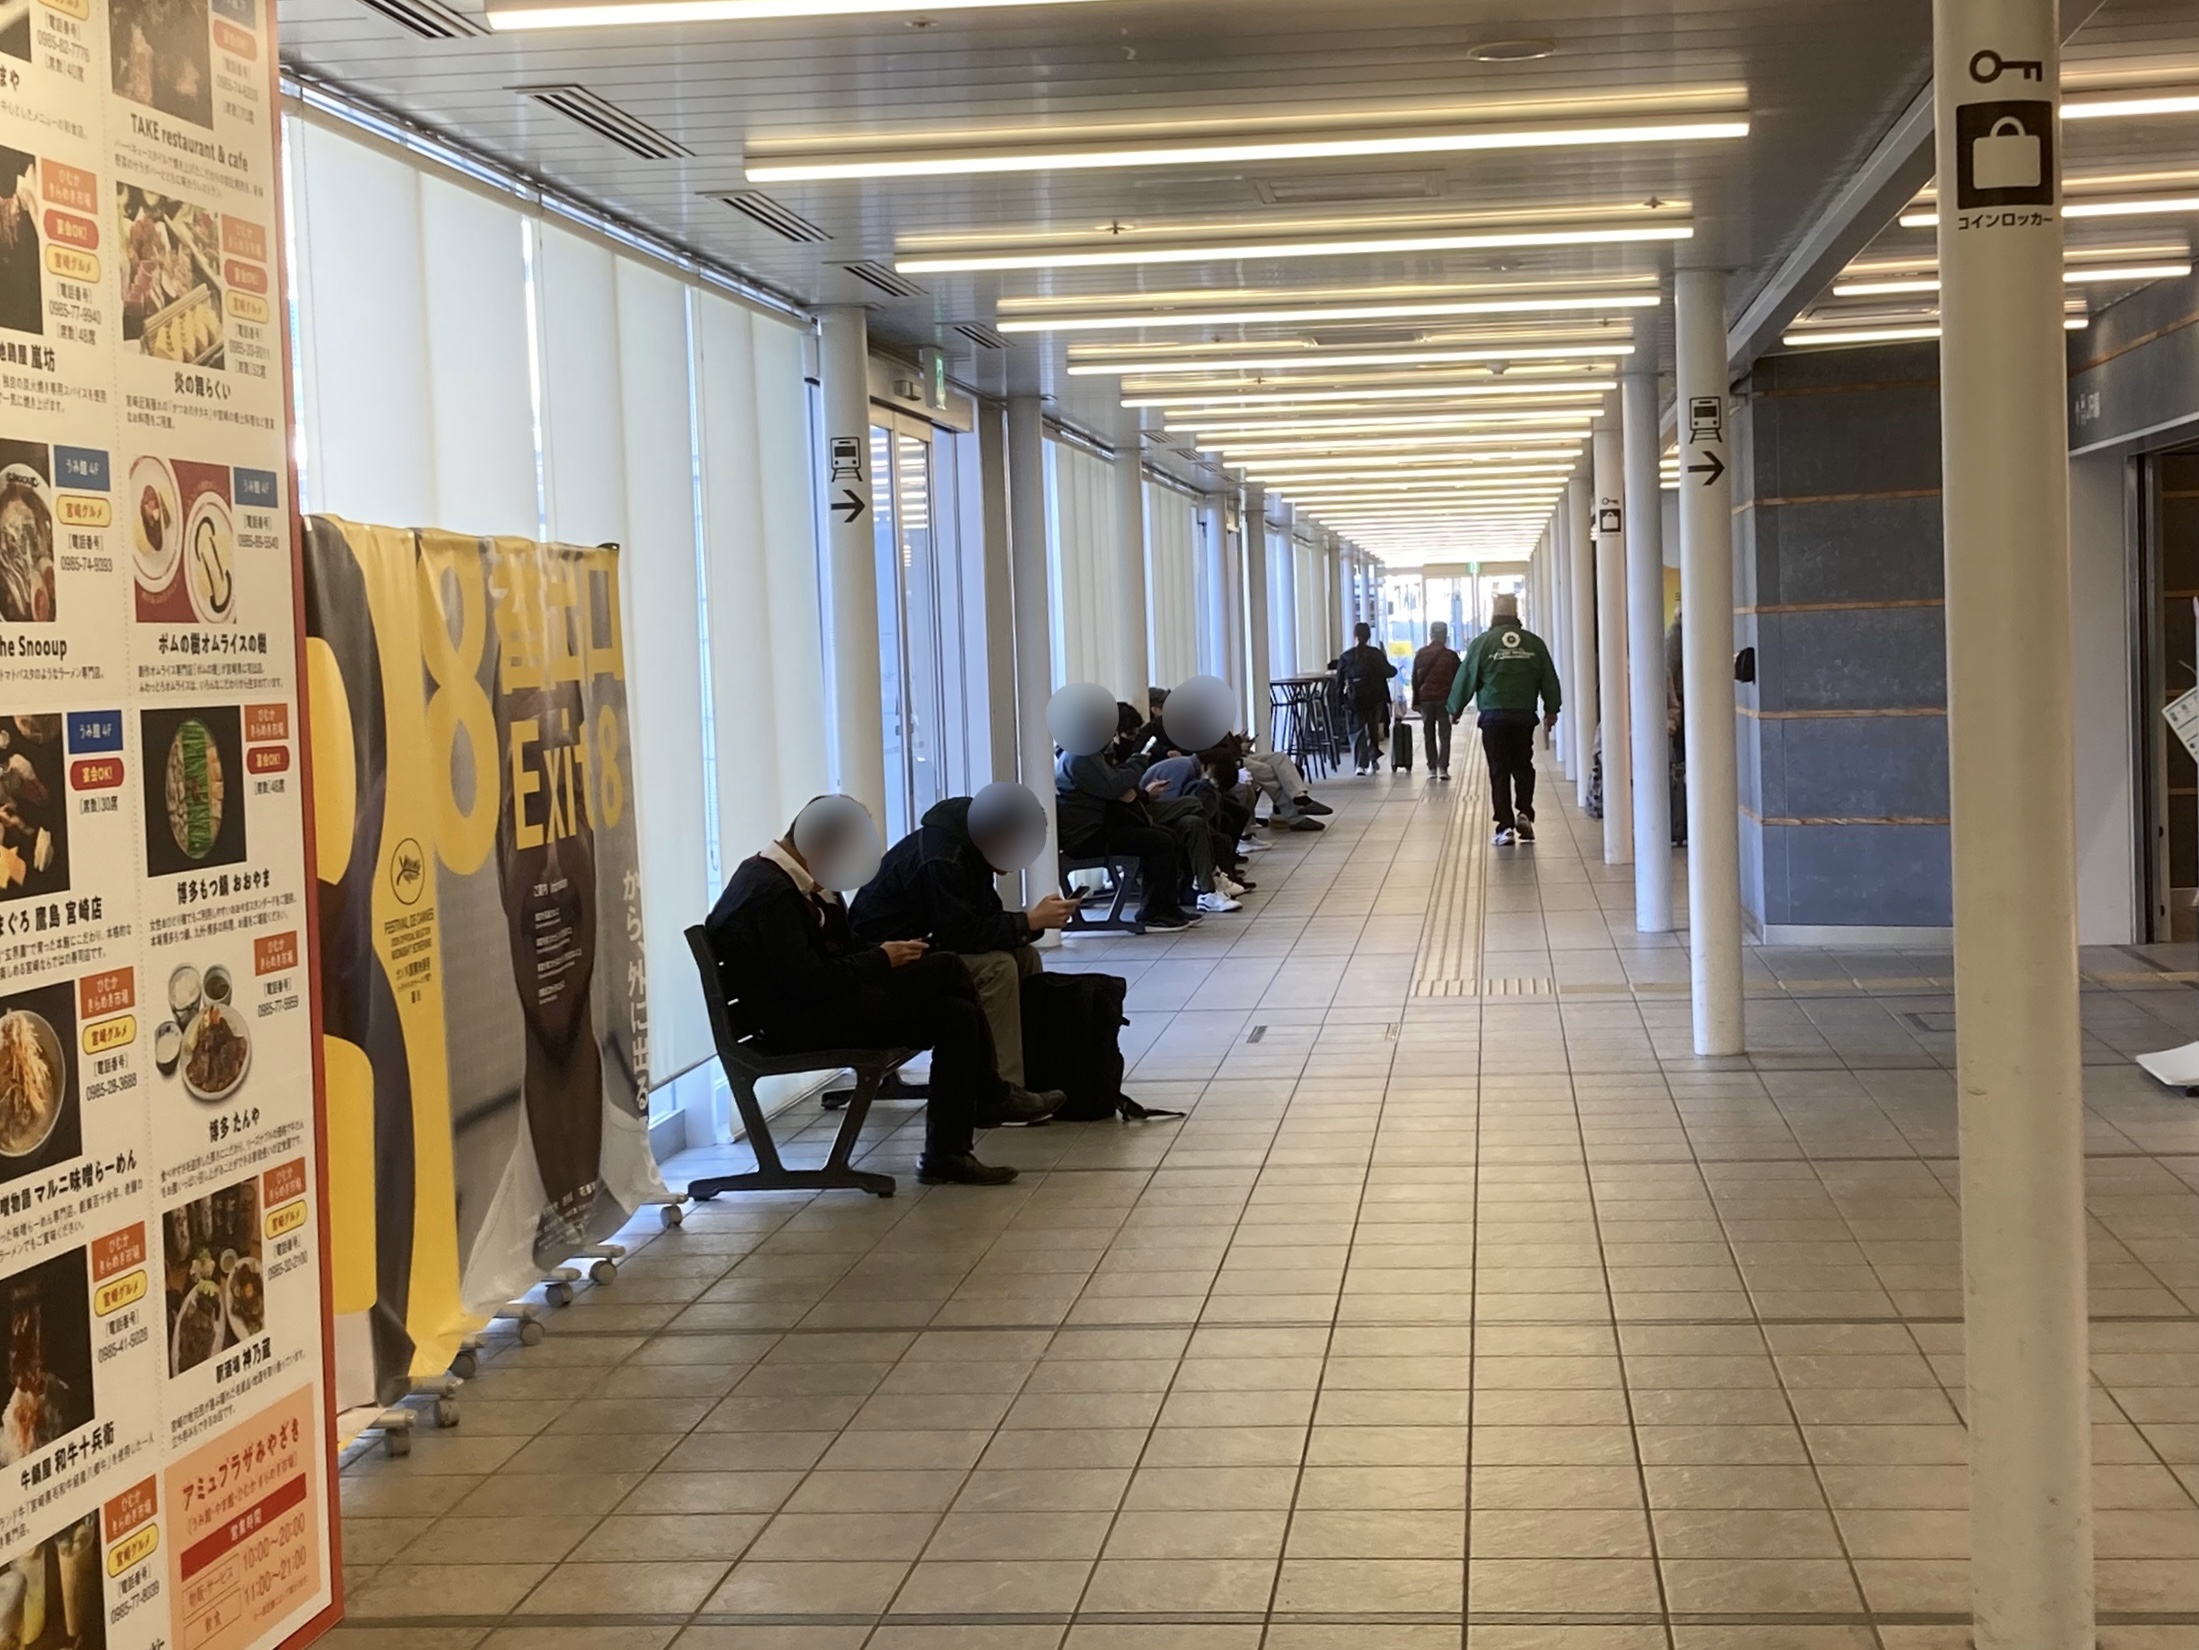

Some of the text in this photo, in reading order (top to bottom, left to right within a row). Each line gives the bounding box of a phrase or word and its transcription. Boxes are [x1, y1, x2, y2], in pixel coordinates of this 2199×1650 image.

[131, 113, 160, 141] TAKE
[162, 129, 215, 160] restaurant
[218, 145, 226, 164] &
[228, 149, 248, 172] cafe
[1958, 213, 2053, 230] コインロッカー
[55, 253, 91, 274] 宮崎グルメ
[66, 502, 102, 520] 宮崎グルメ
[19, 635, 67, 661] Snooup
[79, 723, 112, 740] うみ館 4F
[82, 765, 113, 784] 宴会OK!
[598, 704, 624, 829] 8
[178, 868, 270, 905] 博多もつ鍋 おおやま
[66, 896, 102, 925] 宮崎店
[267, 939, 286, 953] ひむか
[260, 950, 293, 971] きらめき市場
[96, 975, 118, 991] ひむか
[87, 991, 129, 1014] きらめき市場
[91, 1026, 127, 1047] 宮崎グルメ
[209, 1107, 260, 1143] 博多 たんや
[108, 1233, 129, 1253] ひむか
[99, 1247, 140, 1274] きらめき市場
[103, 1280, 139, 1308] 宮崎グルメ
[55, 1421, 115, 1474] 和牛十兵衛
[182, 1417, 299, 1511] アミュプラザみやざき
[121, 1490, 141, 1512] ひむか
[112, 1498, 152, 1535] きらめき市場
[230, 1507, 262, 1542] 営業時間
[116, 1533, 151, 1567] 宮崎グルメ
